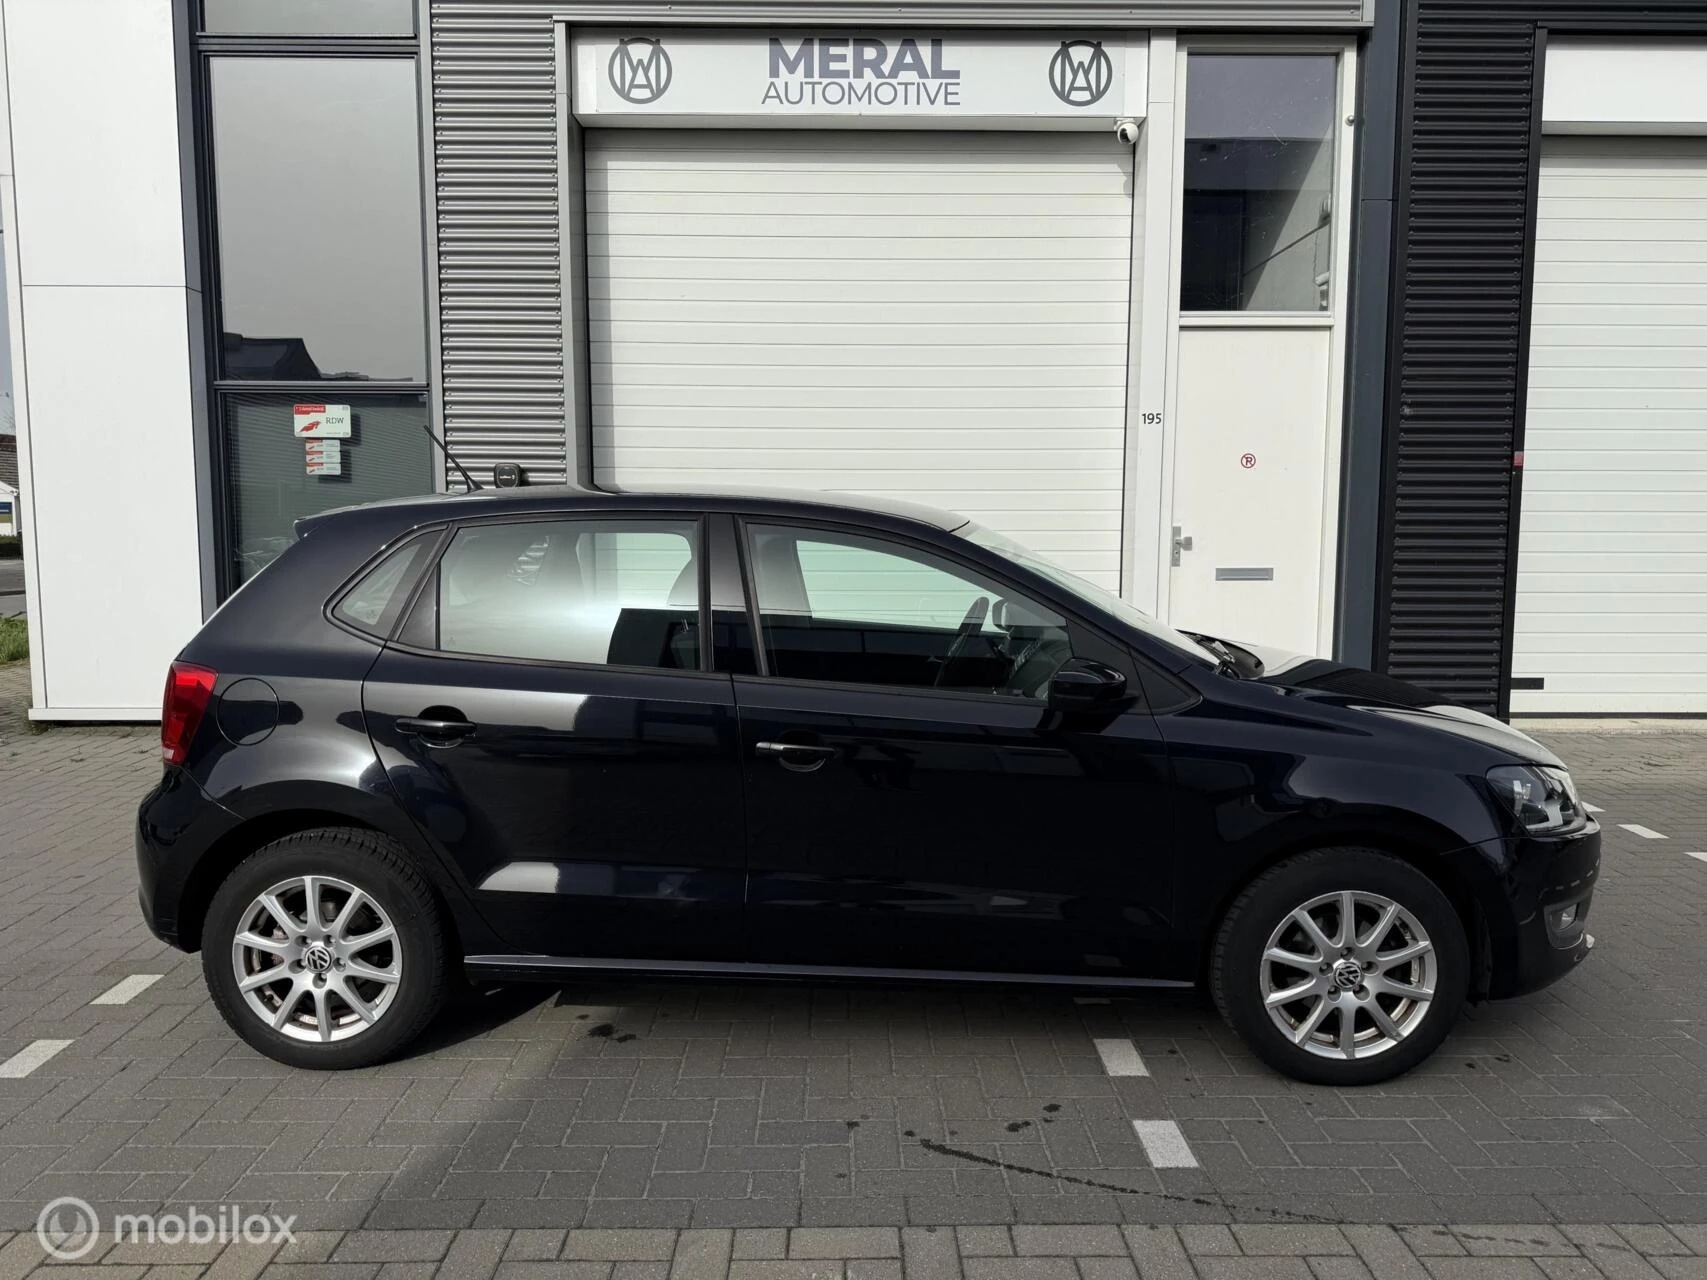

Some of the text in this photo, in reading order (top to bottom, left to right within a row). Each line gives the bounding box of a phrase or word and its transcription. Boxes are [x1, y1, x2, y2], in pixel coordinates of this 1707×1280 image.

[769, 37, 961, 80] MERAL
[761, 81, 961, 106] AUTOMOTIVE
[325, 416, 344, 424] RDW
[1142, 413, 1162, 424] 195
